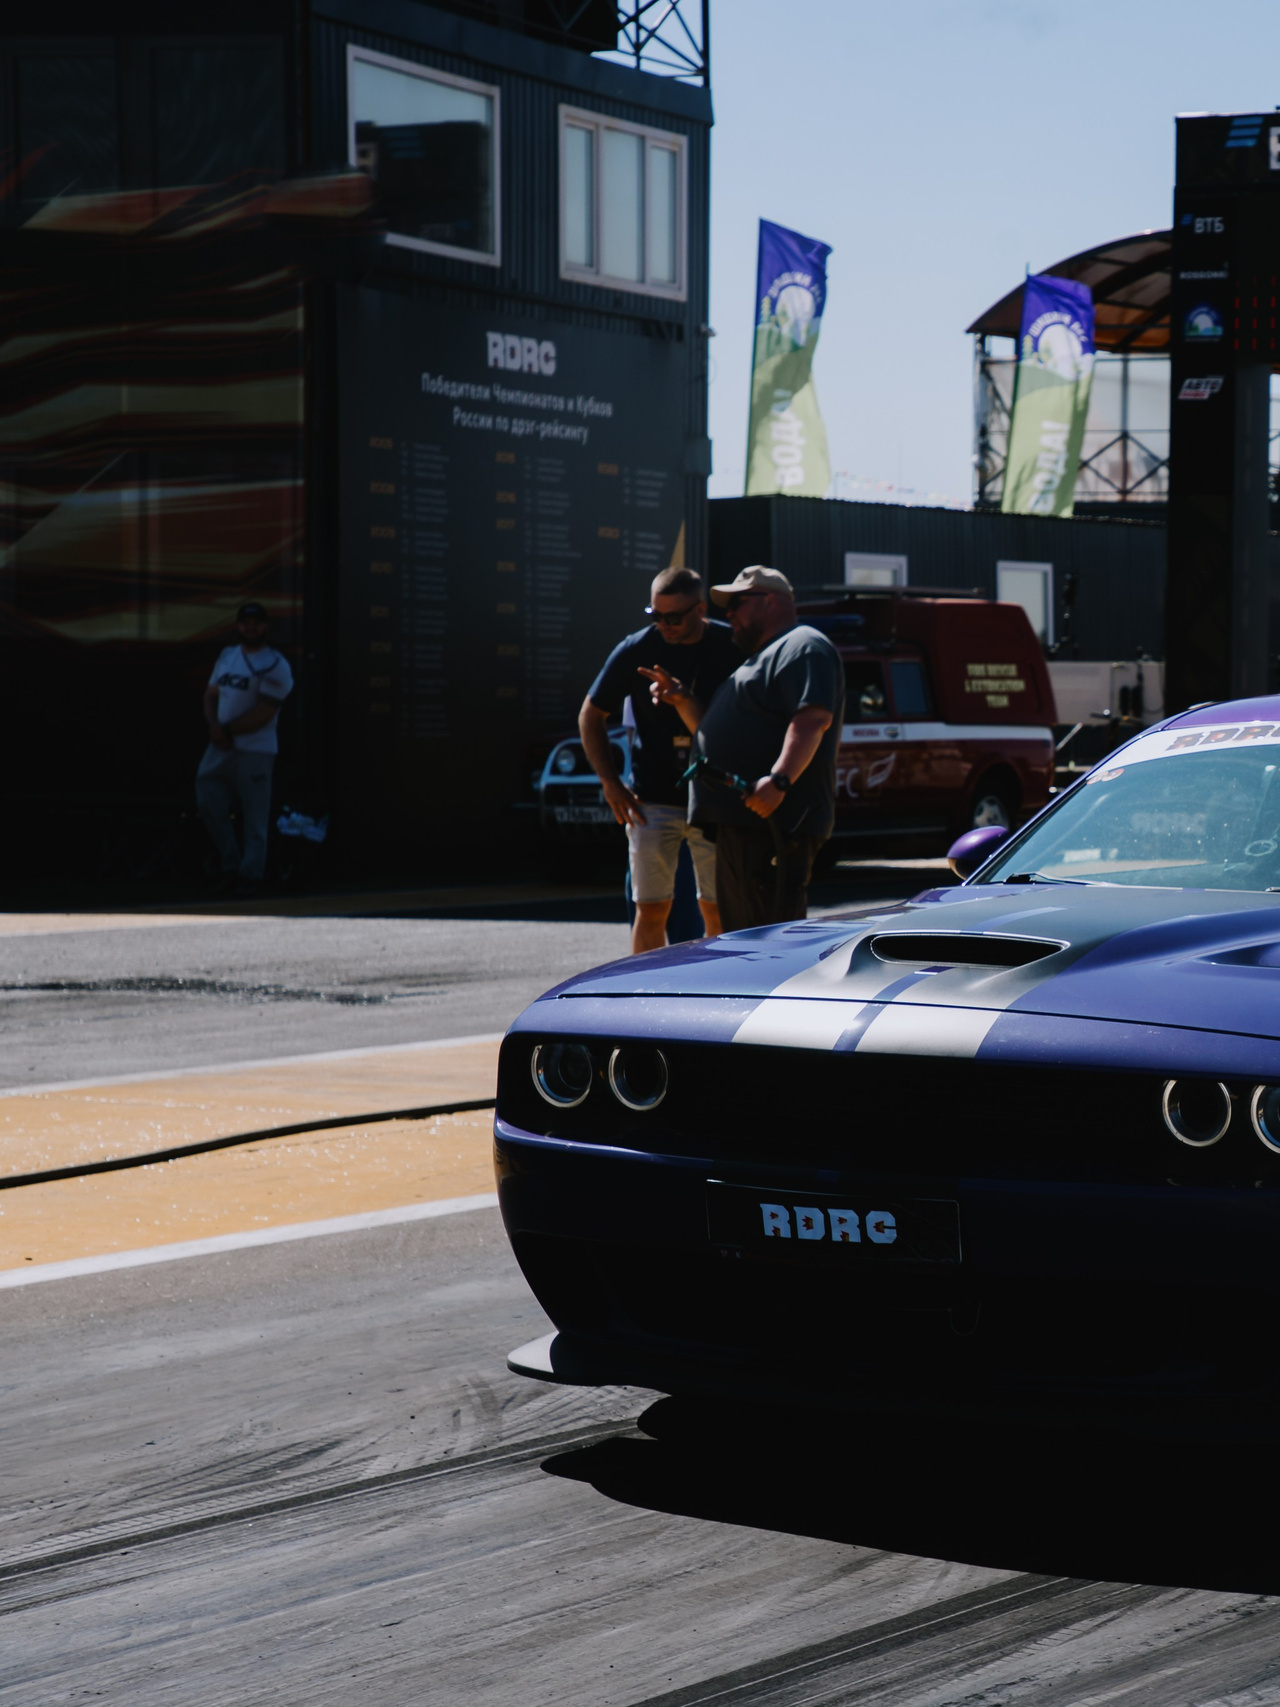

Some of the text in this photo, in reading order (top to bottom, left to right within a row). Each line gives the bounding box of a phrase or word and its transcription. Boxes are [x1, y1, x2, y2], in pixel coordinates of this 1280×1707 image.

[1194, 216, 1225, 234] ВТБ
[486, 331, 556, 377] RDRC
[421, 371, 490, 400] Победители
[493, 382, 564, 413] Чемпионатов
[576, 395, 614, 419] Кубков
[453, 405, 589, 446] России по дрэг-рейсингу
[759, 1202, 899, 1245] RDRC
